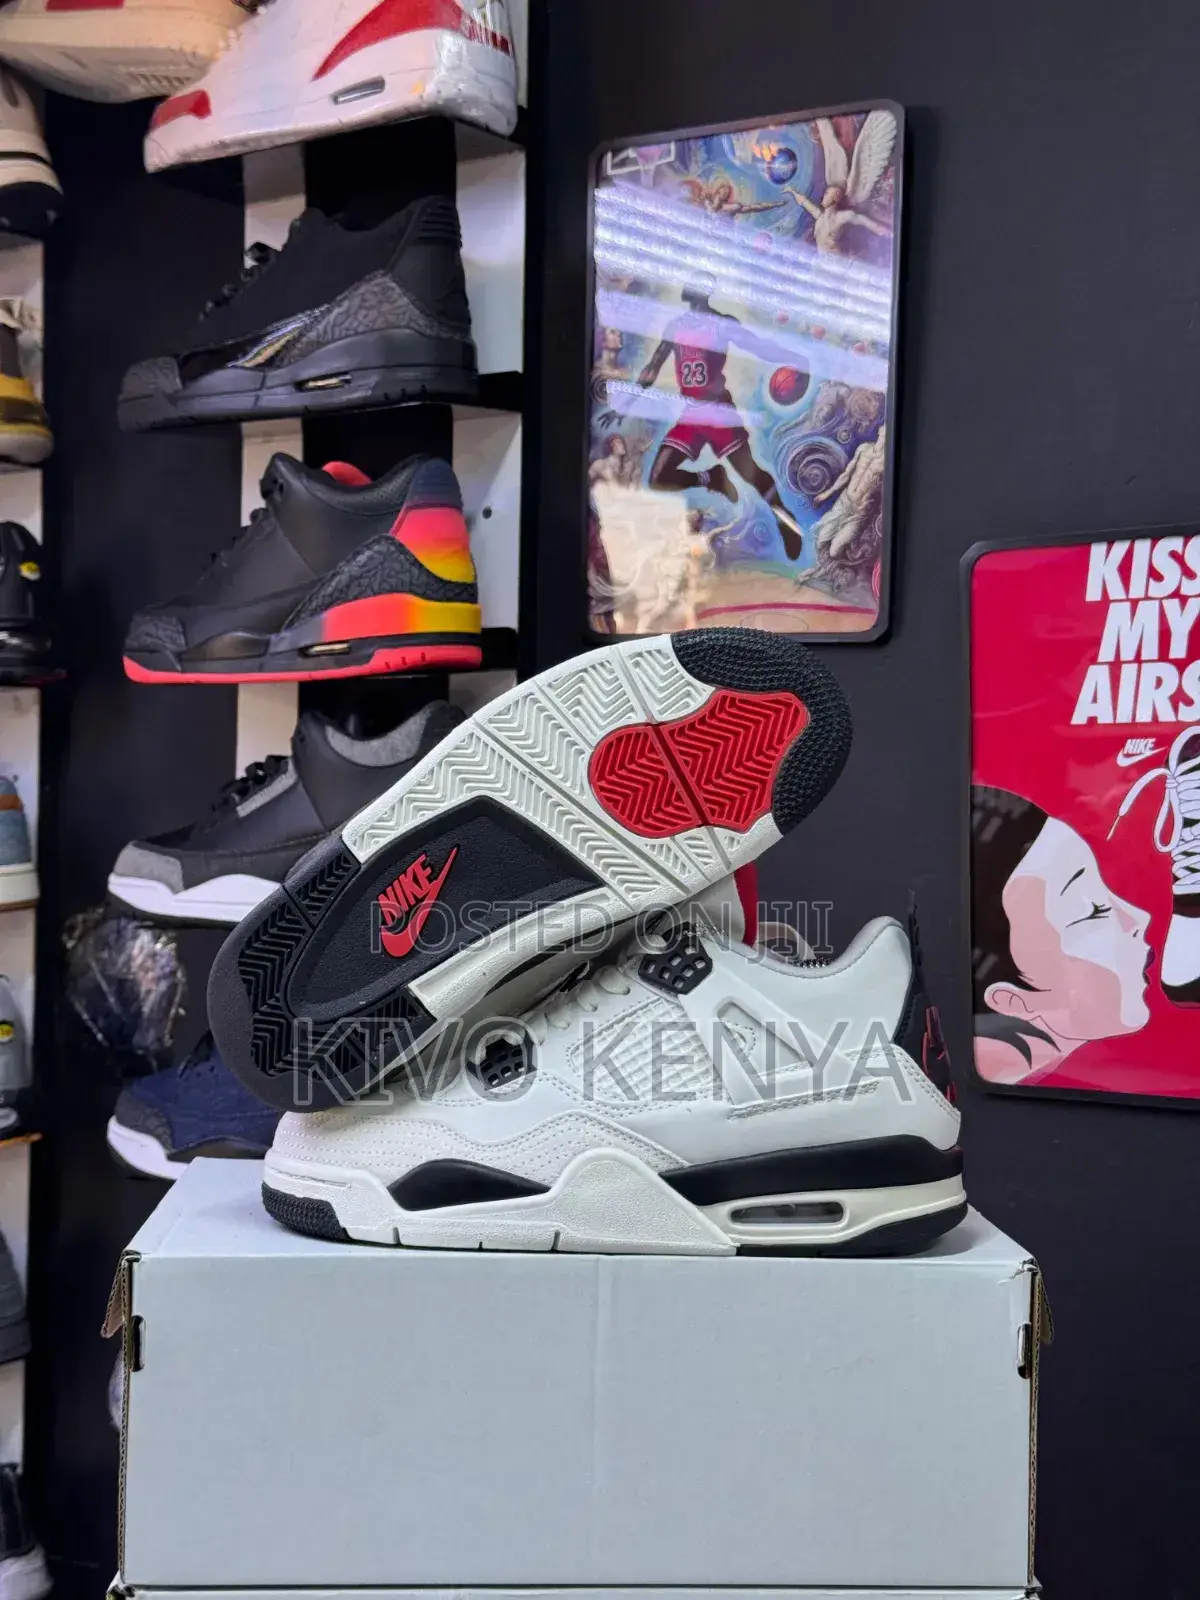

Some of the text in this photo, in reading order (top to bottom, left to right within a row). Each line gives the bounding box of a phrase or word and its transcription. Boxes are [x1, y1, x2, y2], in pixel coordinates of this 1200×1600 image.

[681, 361, 708, 388] 23
[1097, 597, 1200, 663] MY
[1070, 659, 1200, 725] AIRS
[1122, 737, 1156, 755] NIKE
[378, 853, 435, 925] NIKE
